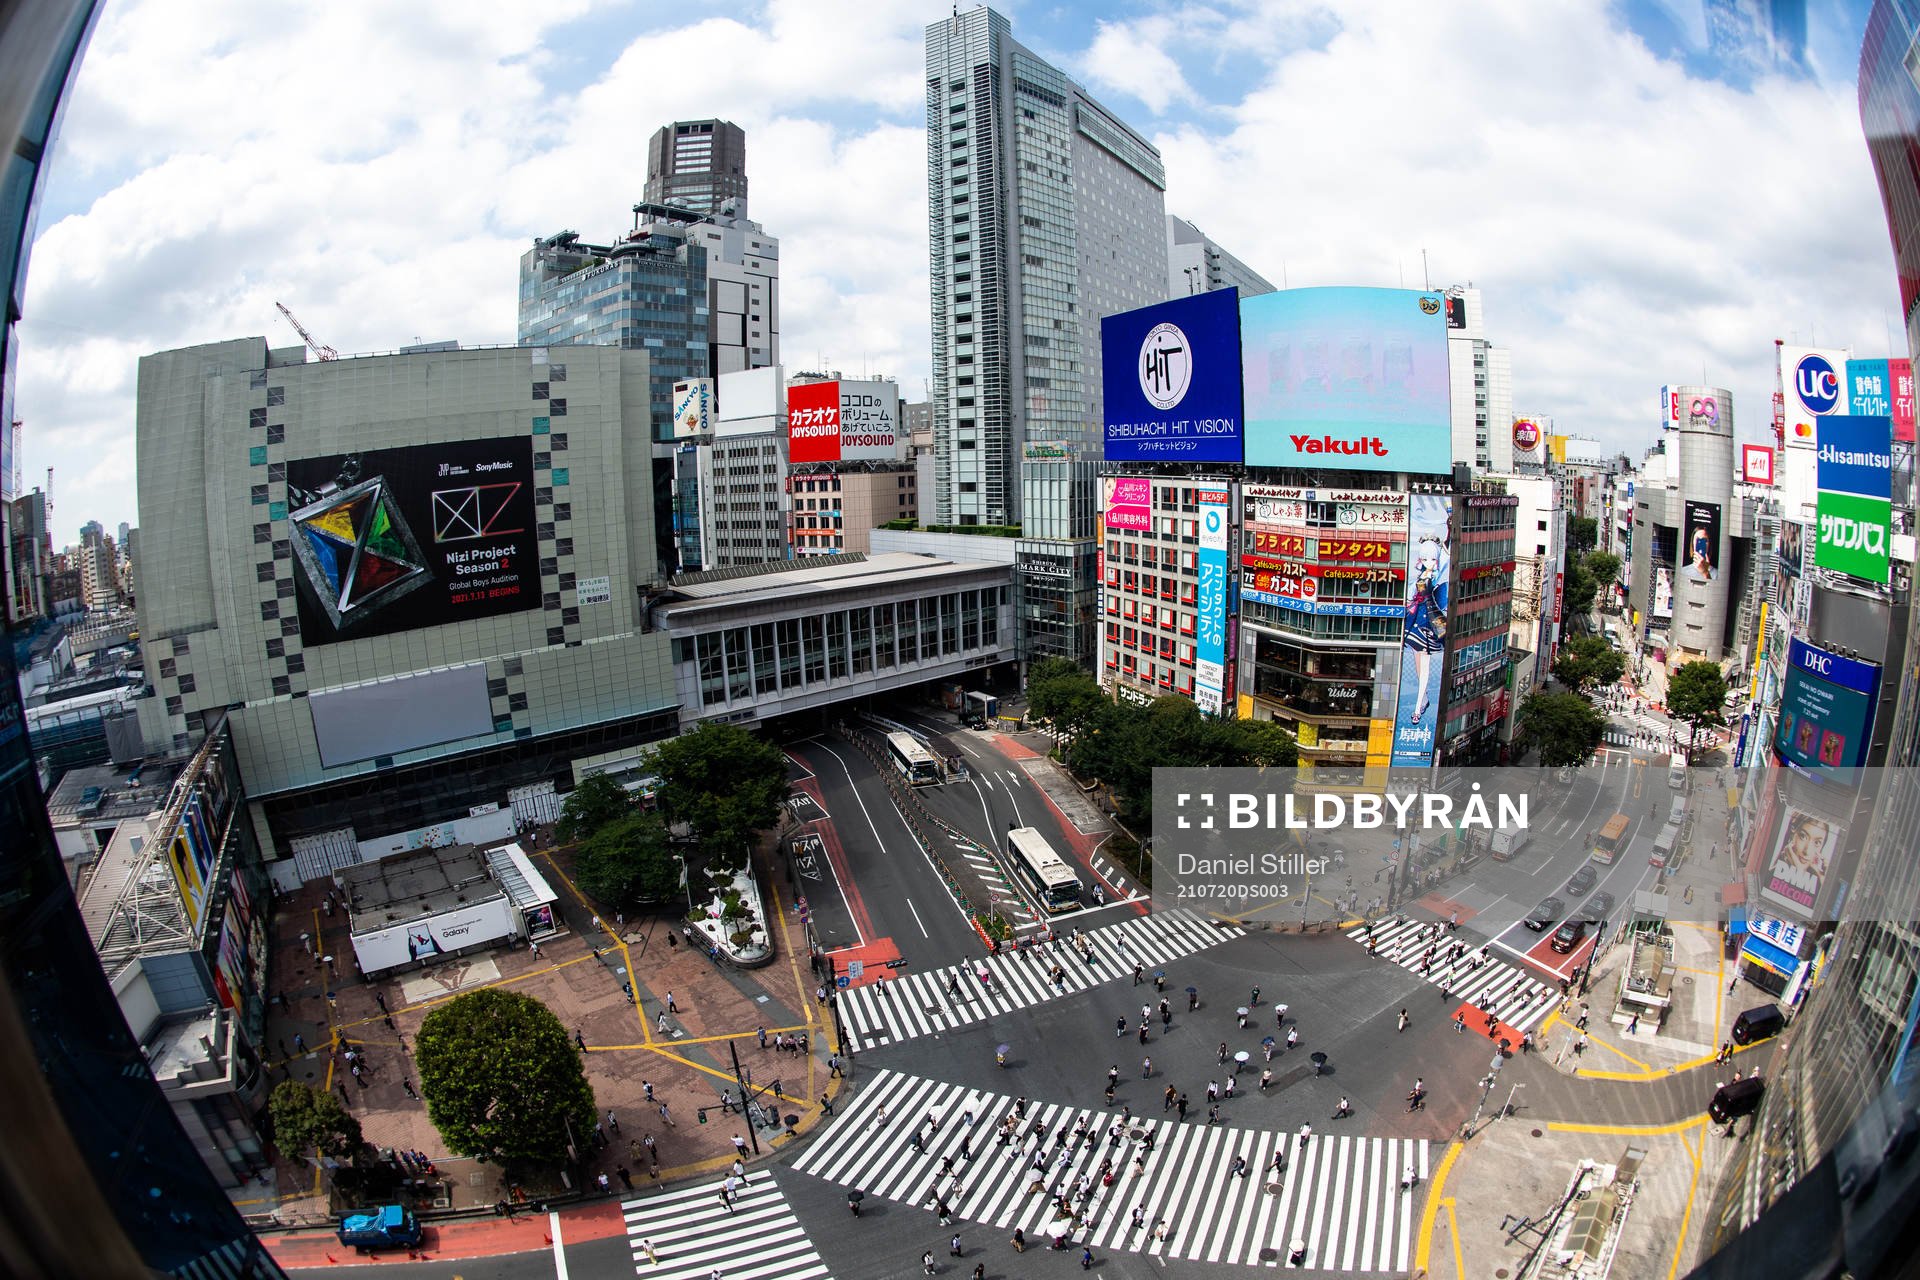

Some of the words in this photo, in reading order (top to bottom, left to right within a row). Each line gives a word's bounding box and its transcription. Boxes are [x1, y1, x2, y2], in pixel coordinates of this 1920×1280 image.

[1163, 323, 1180, 334] GINZA
[841, 394, 882, 407] ココロの
[791, 406, 838, 426] カラオケ
[791, 424, 839, 438] JOYSOUND
[841, 422, 894, 433] あげていこう。
[1108, 421, 1167, 437] SHIBUHACHI
[1172, 420, 1190, 434] HIT
[1194, 418, 1234, 434] VISION
[841, 434, 894, 447] JOYSOUND
[1289, 434, 1389, 457] Yakult
[1818, 444, 1890, 468] Hisamitsu
[1245, 503, 1255, 513] 9F
[1361, 507, 1405, 524] しゃぶ葉
[1821, 514, 1886, 557] サロンパス
[446, 550, 469, 564] Nizi
[471, 544, 517, 561] Project
[1319, 541, 1388, 557] コンタクト
[455, 560, 500, 576] Season
[501, 558, 510, 569] 2
[1020, 564, 1046, 572] MARK
[1049, 567, 1071, 575] CITY
[449, 579, 471, 591] Global
[472, 578, 490, 588] Boys
[490, 573, 519, 584] Audition
[1244, 572, 1255, 583] 7F
[1270, 574, 1300, 595] ガスト
[488, 585, 521, 598] BEGINS
[1344, 605, 1405, 616] 英会話イーオン
[1804, 649, 1832, 676] DHC
[1772, 859, 1818, 895] DMM
[1769, 877, 1814, 907] Bitcoin
[443, 926, 469, 938] Galaxy
